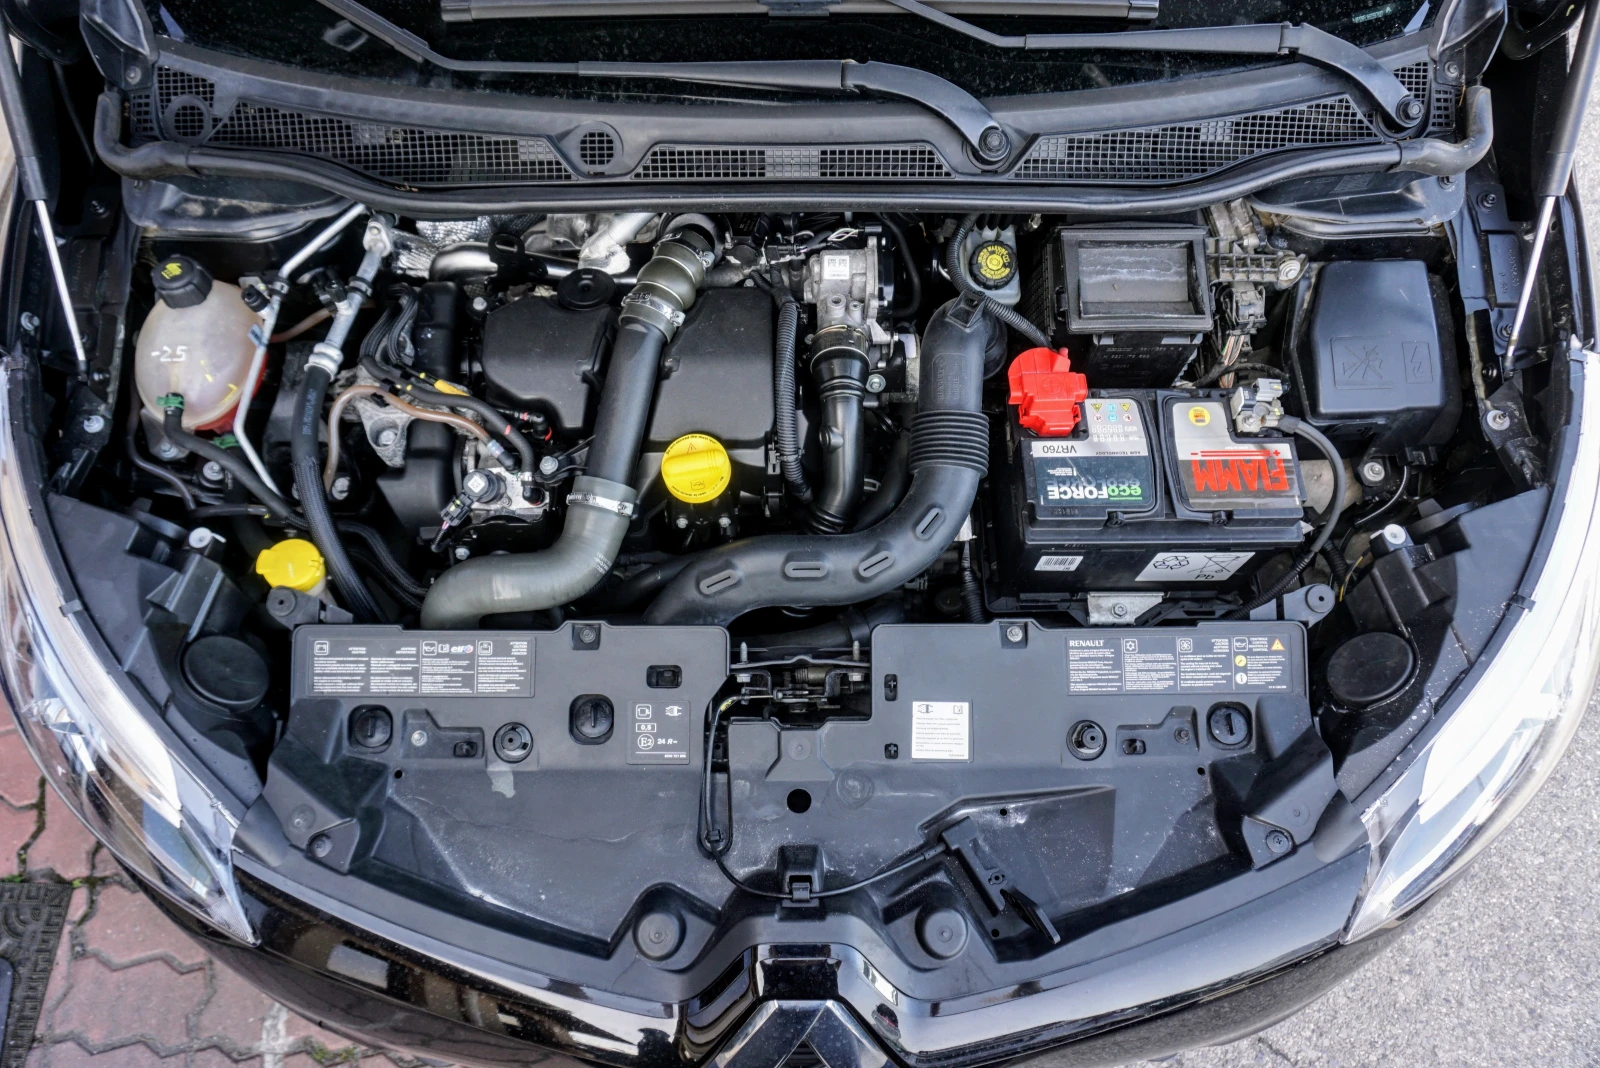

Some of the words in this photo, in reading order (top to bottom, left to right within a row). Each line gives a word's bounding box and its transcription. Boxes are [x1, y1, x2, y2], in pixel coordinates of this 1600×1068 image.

[151, 345, 188, 362] -25
[1042, 445, 1077, 454] VR760
[1191, 458, 1290, 491] FIAMM
[1047, 486, 1142, 500] ecoFORCE
[450, 645, 466, 653] elf
[641, 737, 653, 747] E2
